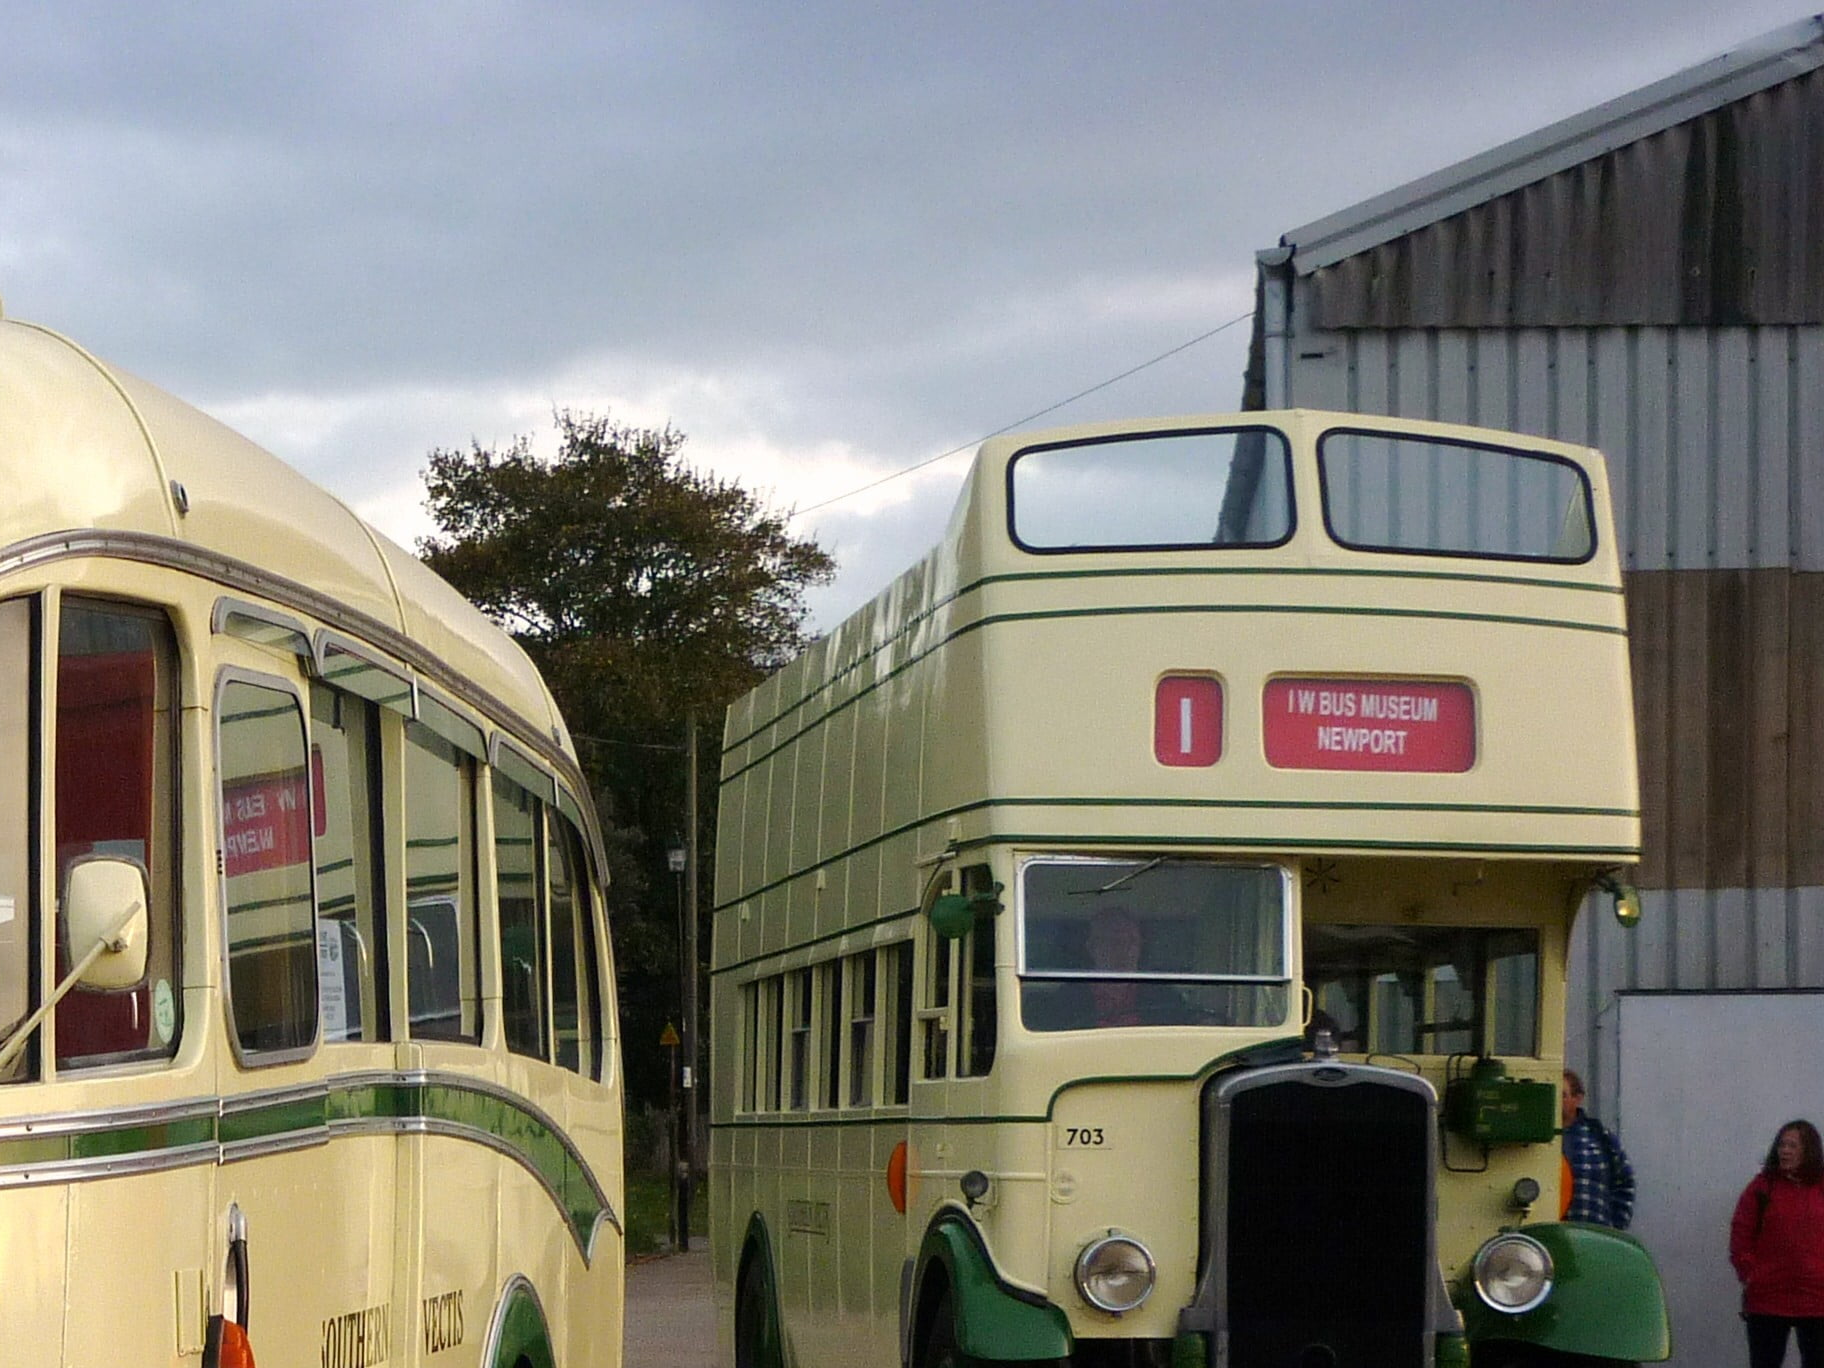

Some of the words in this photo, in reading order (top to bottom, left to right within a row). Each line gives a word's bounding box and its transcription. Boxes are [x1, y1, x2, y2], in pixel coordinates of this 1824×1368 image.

[1298, 690, 1316, 715] W
[1319, 691, 1356, 717] BUS
[1361, 694, 1438, 722] MUSEUM
[1317, 726, 1408, 755] NEWPORT
[1066, 1128, 1104, 1145] 703
[423, 1289, 464, 1356] VECTIS
